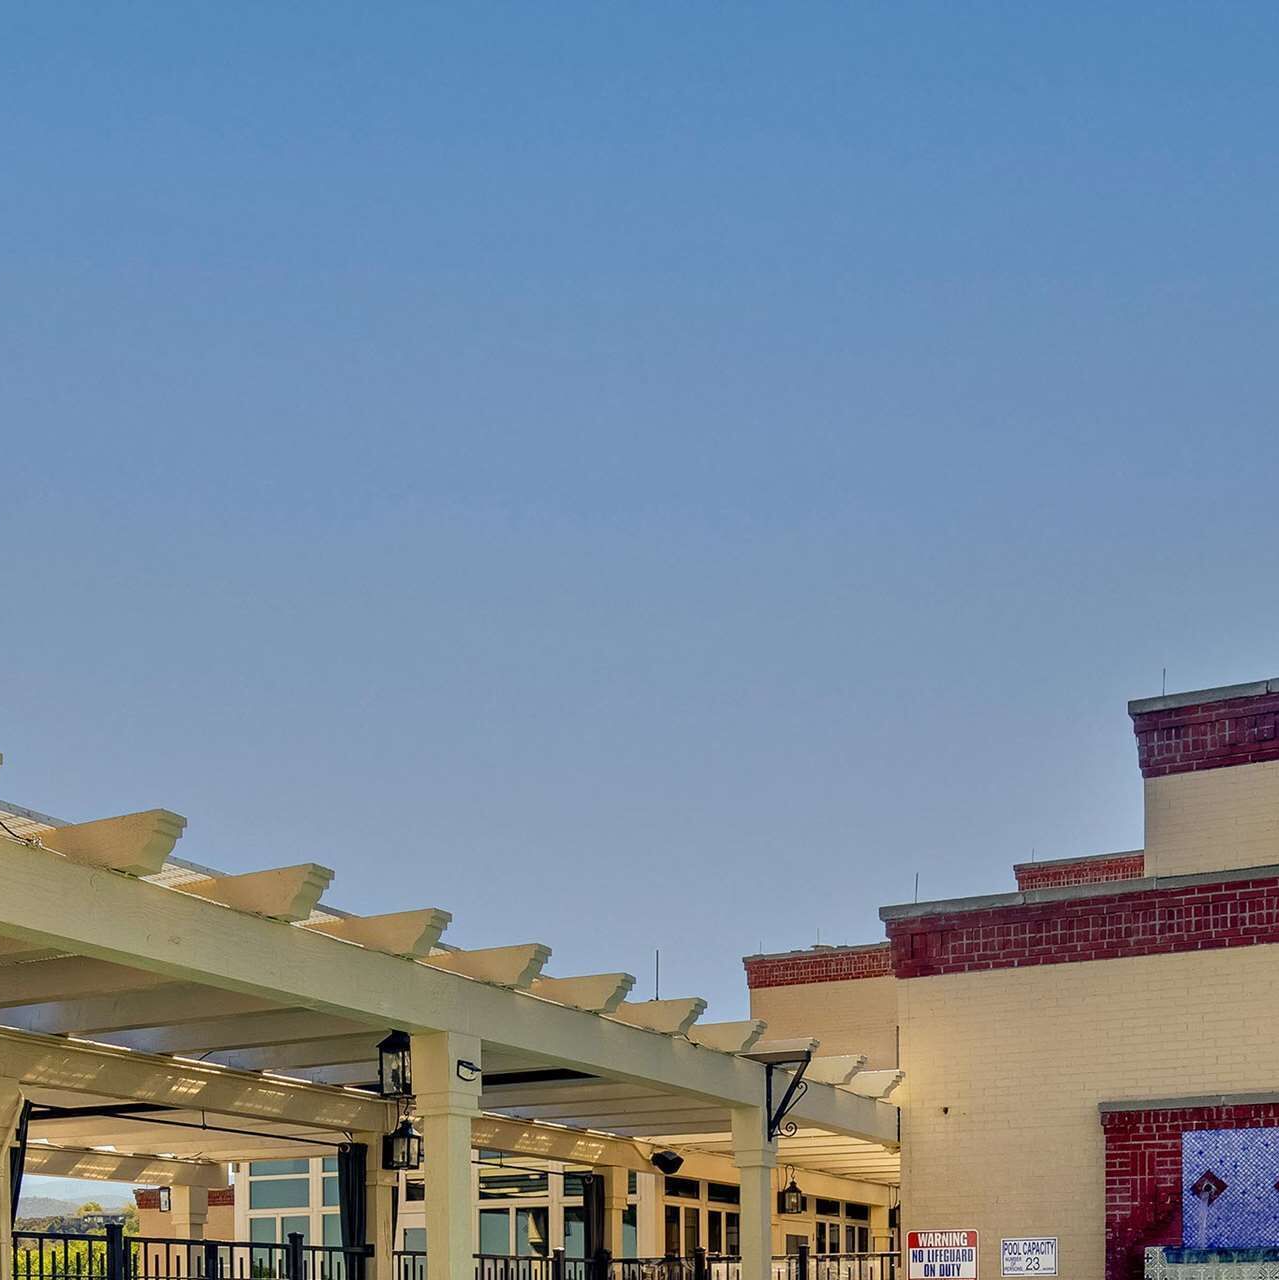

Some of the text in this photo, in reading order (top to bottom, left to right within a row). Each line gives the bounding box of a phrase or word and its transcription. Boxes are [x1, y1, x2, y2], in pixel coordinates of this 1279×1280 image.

[917, 1232, 968, 1247] WARNING
[912, 1248, 974, 1263] NO LIFEGUARD
[1003, 1241, 1055, 1256] POOL CAPACITY
[923, 1263, 961, 1277] ON DUTY
[1025, 1256, 1040, 1271] 23
